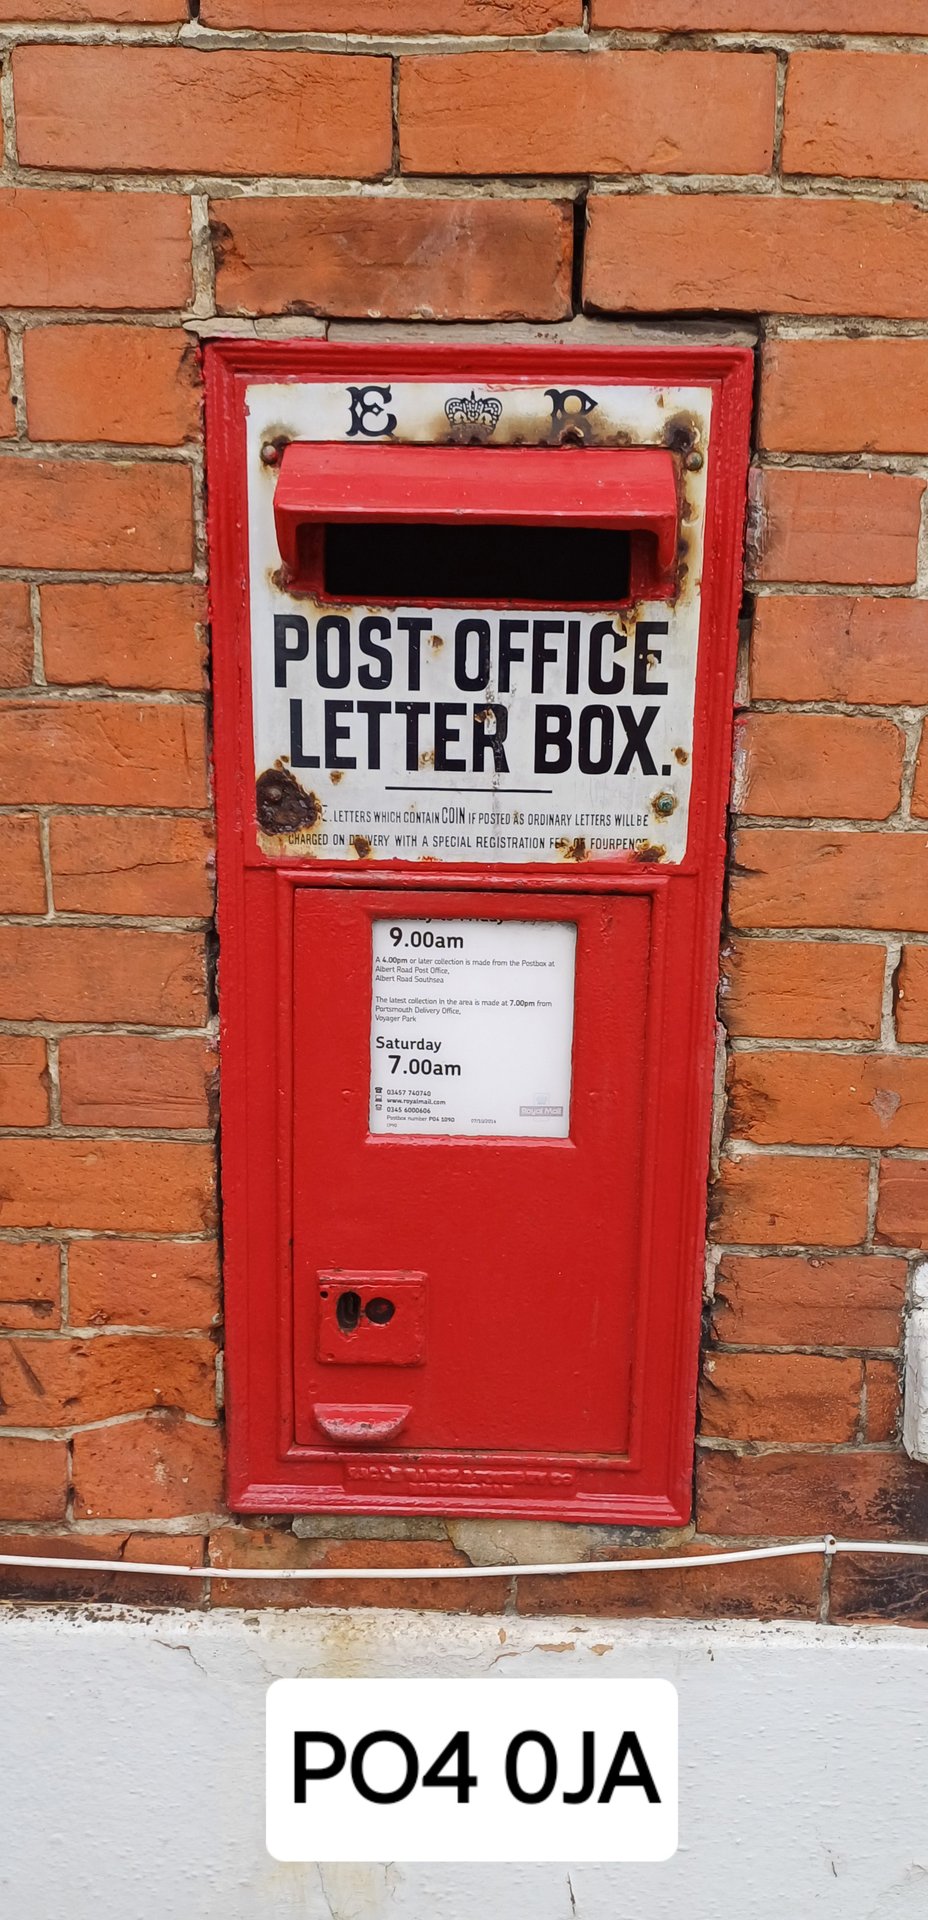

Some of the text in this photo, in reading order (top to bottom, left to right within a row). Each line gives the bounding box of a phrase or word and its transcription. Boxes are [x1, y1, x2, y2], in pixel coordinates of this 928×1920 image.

[346, 385, 598, 440] E R
[273, 614, 669, 696] POST OFFICE
[289, 698, 671, 776] LETTER BOX.
[334, 810, 371, 823] LETTERS
[374, 811, 400, 823] WHICH
[403, 811, 440, 824] CONTAIN
[441, 806, 465, 824] COIN
[468, 813, 477, 824] IF
[479, 813, 510, 825] POSTED
[513, 813, 525, 825] AS
[527, 813, 572, 826] ORDINARY
[575, 814, 611, 827] LETTERS
[614, 814, 635, 827] WILL
[636, 814, 649, 827] BE
[288, 834, 328, 846] CHARGED
[333, 834, 345, 846] ON
[394, 835, 417, 846] WITH
[422, 835, 429, 847] A
[433, 836, 471, 847] SPECIAL
[476, 836, 545, 849] REGISTRATION
[390, 927, 463, 948] 9.00am
[382, 957, 408, 966] 4.00pm
[418, 957, 433, 965] later
[434, 957, 464, 966] collection
[465, 958, 471, 966] is
[472, 958, 490, 966] made
[491, 959, 508, 967] from
[509, 959, 520, 967] the
[522, 960, 547, 968] Postbox
[548, 960, 555, 968] at
[375, 966, 450, 975] Albert Road Post Office,
[375, 975, 444, 984] Albert Road Southsea
[389, 996, 407, 1004] latest
[407, 997, 437, 1005] collection
[474, 998, 480, 1006] is
[481, 998, 500, 1006] made
[500, 999, 508, 1007] at
[509, 1000, 535, 1008] 7.00pm
[375, 1005, 461, 1015] Portsmouth Delivery Office,
[375, 1014, 416, 1023] Voyager Park
[376, 1036, 441, 1053] Saturday
[388, 1055, 461, 1076] 7.00am
[386, 1098, 446, 1106] www.royalmail.com
